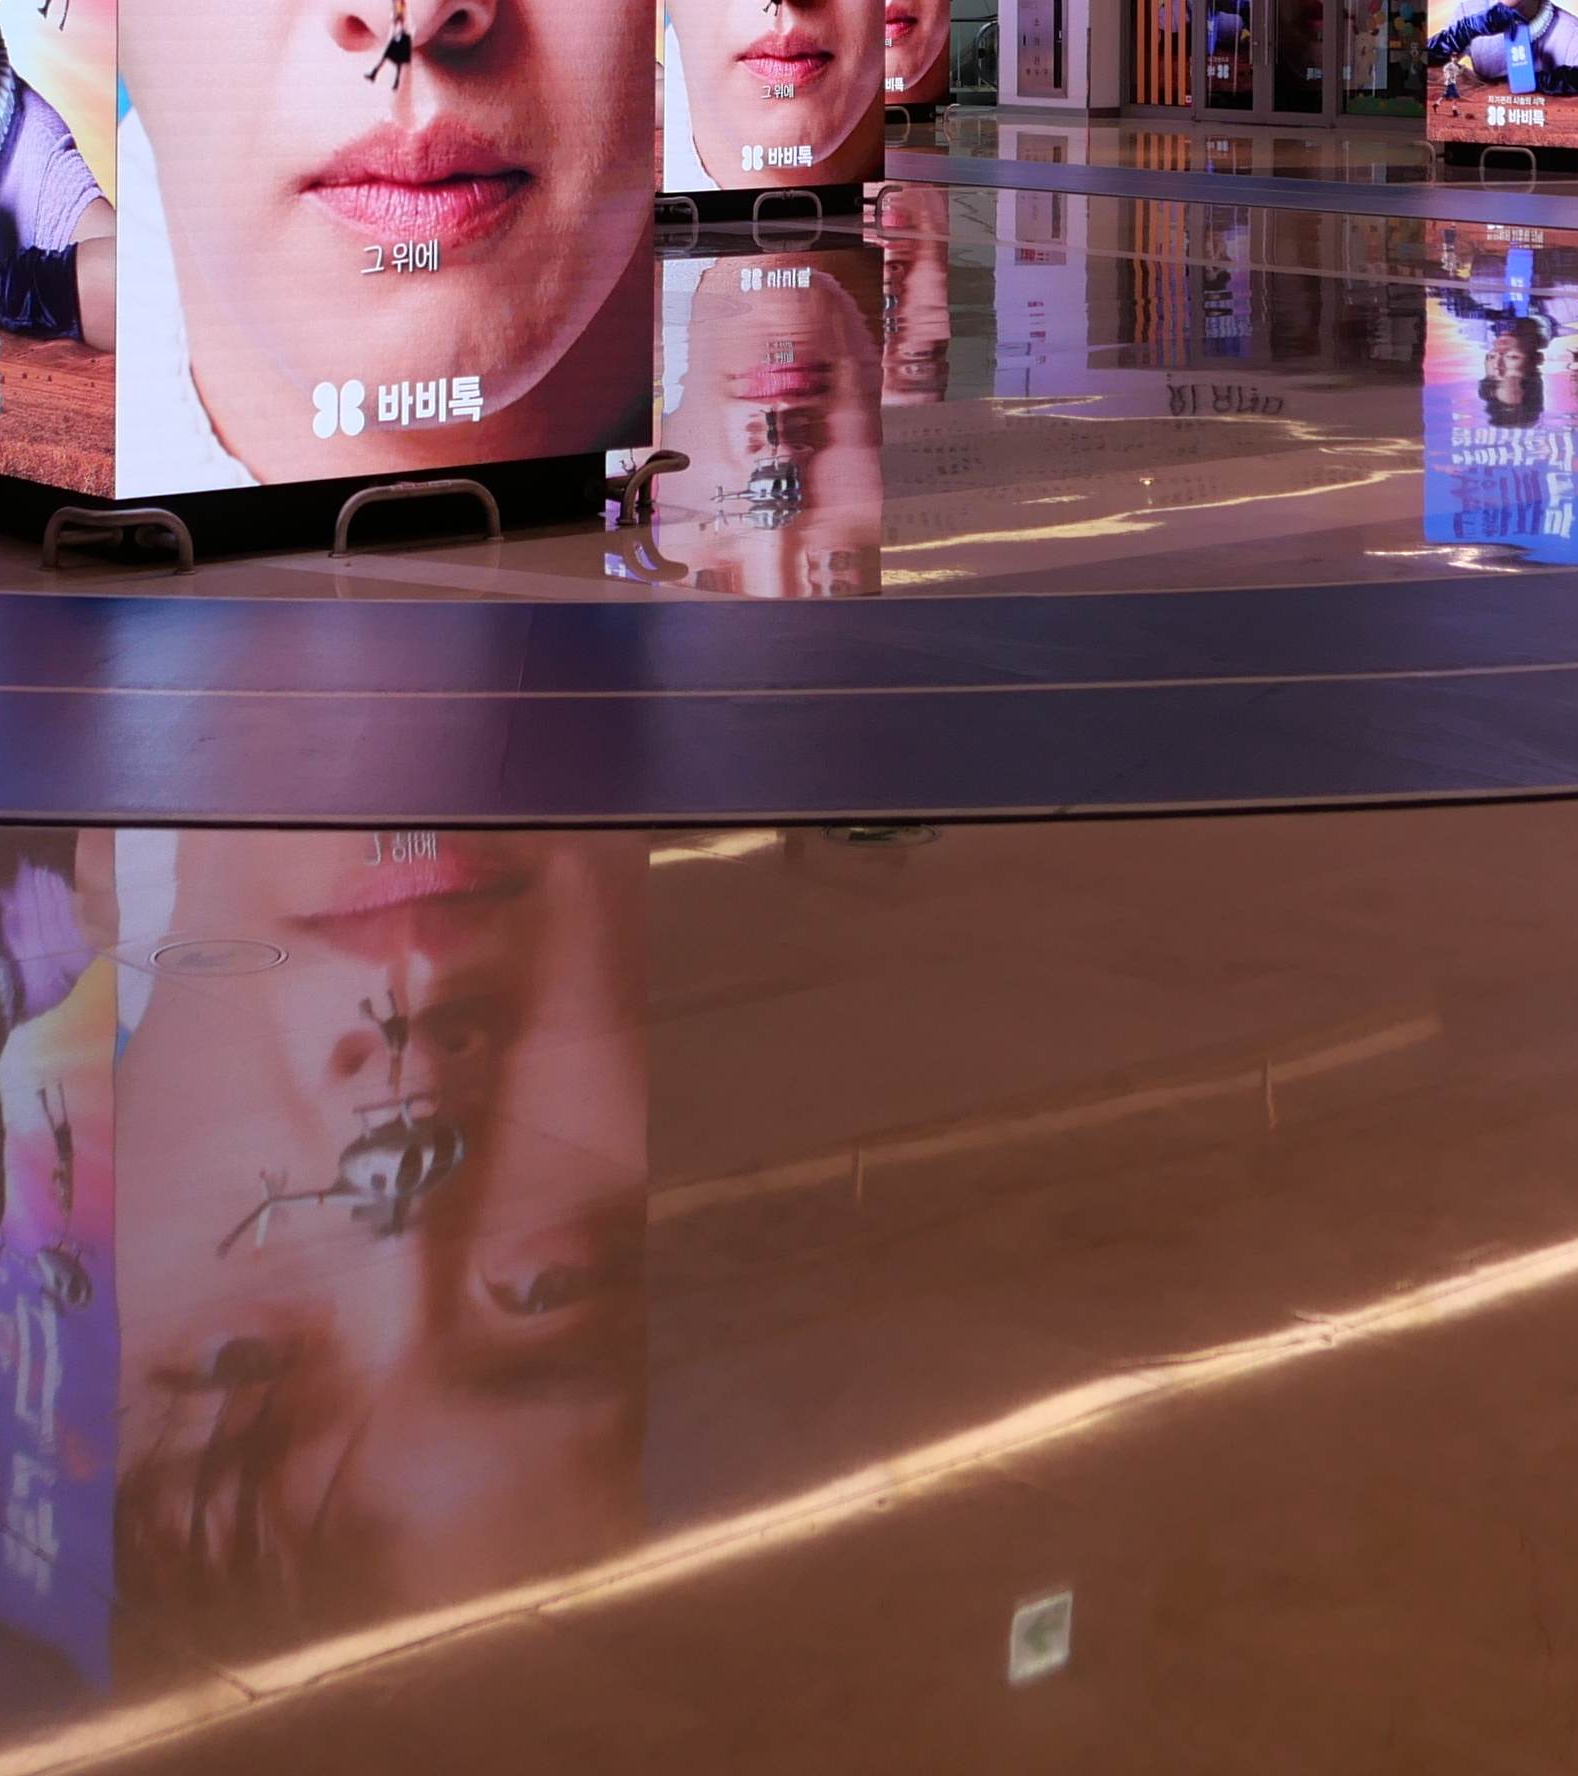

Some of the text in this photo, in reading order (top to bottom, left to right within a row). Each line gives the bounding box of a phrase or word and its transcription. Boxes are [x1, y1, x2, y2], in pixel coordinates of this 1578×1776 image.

[1508, 108, 1545, 128] 바비톡
[768, 145, 814, 168] 바비톡
[361, 238, 439, 274] 그 위에
[377, 375, 484, 426] 바비톡
